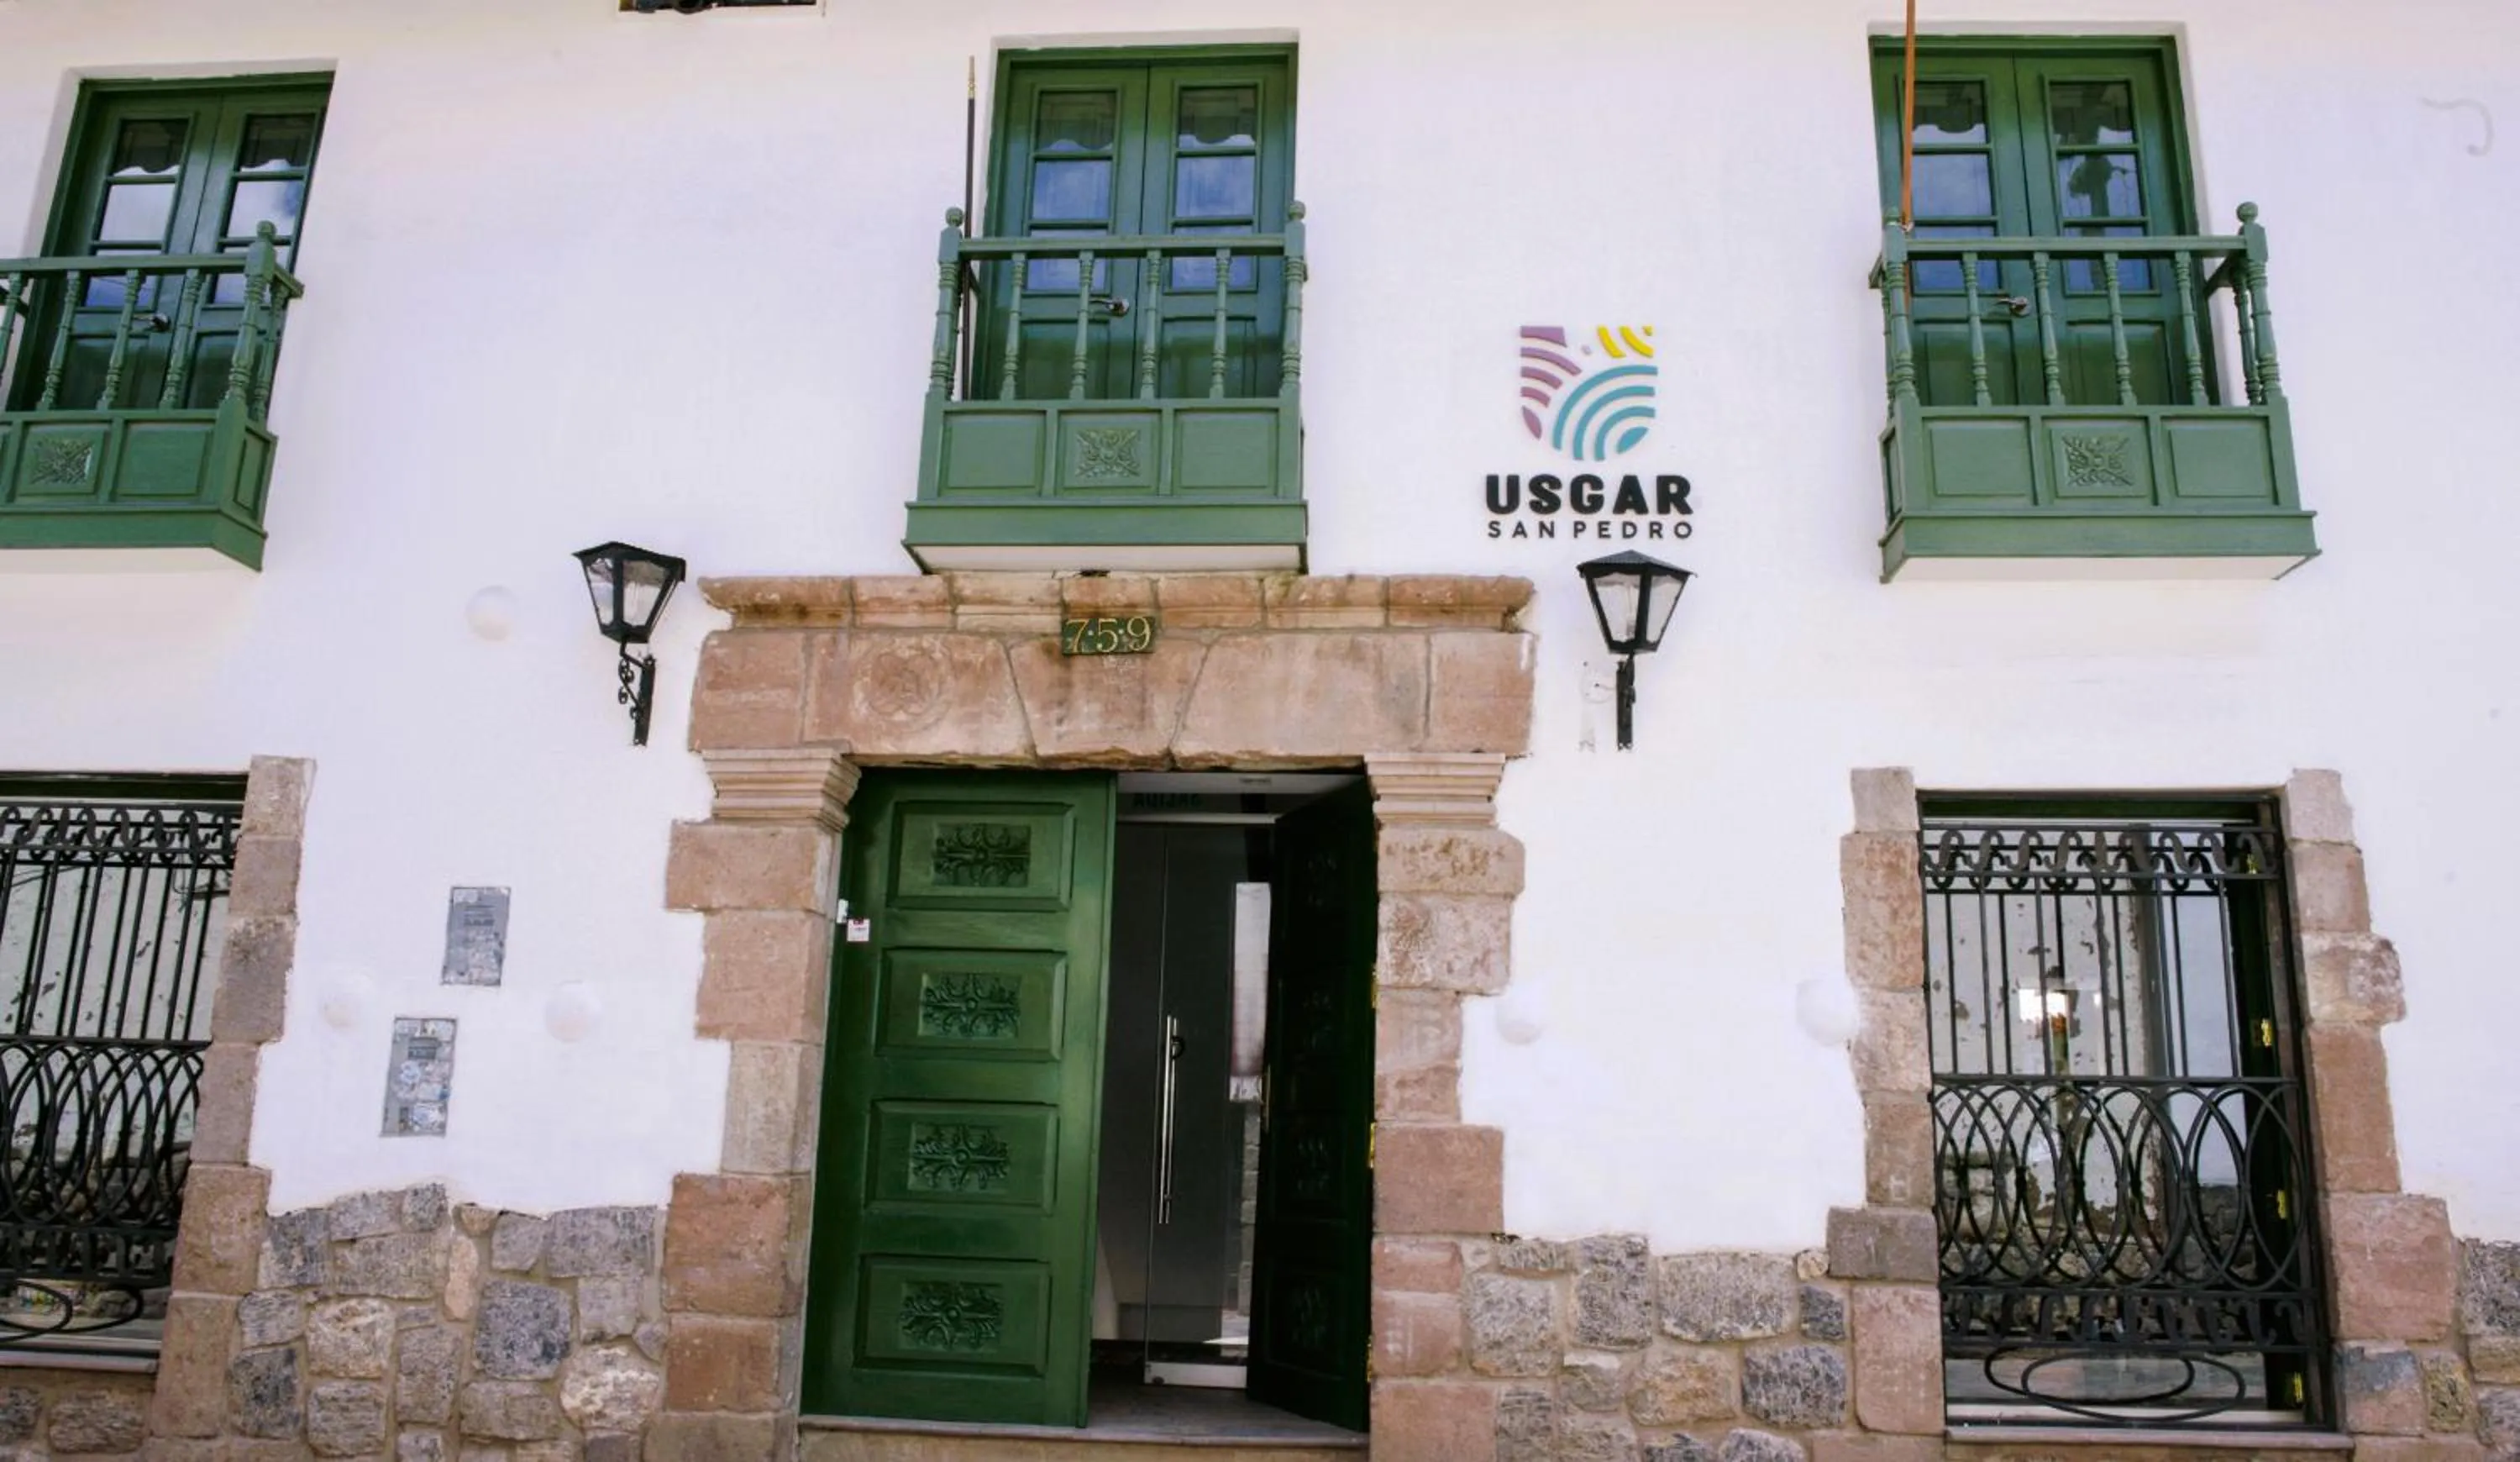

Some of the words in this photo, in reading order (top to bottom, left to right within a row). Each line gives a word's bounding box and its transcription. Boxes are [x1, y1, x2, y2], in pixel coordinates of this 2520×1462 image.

[1486, 474, 1693, 515] USGAR
[1488, 521, 1554, 538] SAN
[1574, 521, 1692, 539] PEDRO
